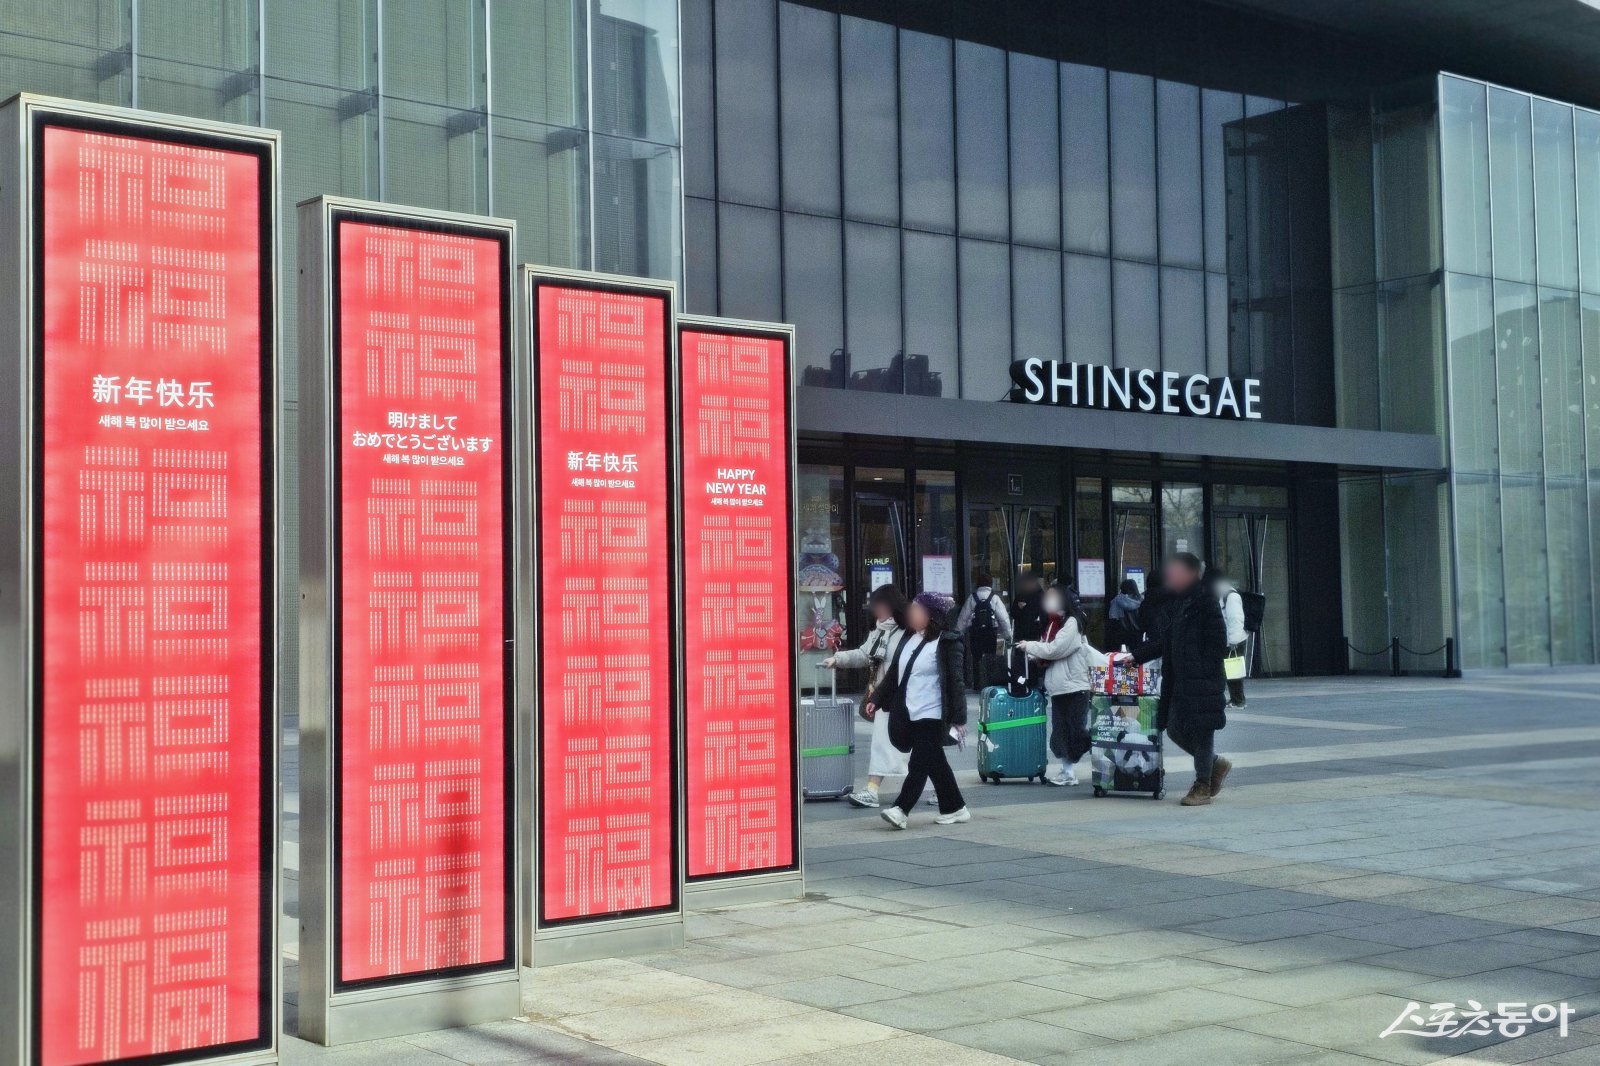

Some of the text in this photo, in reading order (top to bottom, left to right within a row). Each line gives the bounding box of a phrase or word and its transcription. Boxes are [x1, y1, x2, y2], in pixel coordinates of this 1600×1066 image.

[92, 374, 215, 409] 新年快乐
[1024, 357, 1262, 419] SHINSEGAE
[98, 415, 209, 431] 새해 복 많이 받으세요
[388, 411, 458, 430] 明けまして
[352, 431, 493, 453] おめでとうございます
[382, 454, 465, 466] 새해 복 많이 받으세요
[567, 451, 638, 473] 新年快乐
[717, 468, 755, 480] HAPPY
[571, 478, 635, 489] 새해 복 많이 받으세요
[706, 482, 766, 496] NEW YEAR
